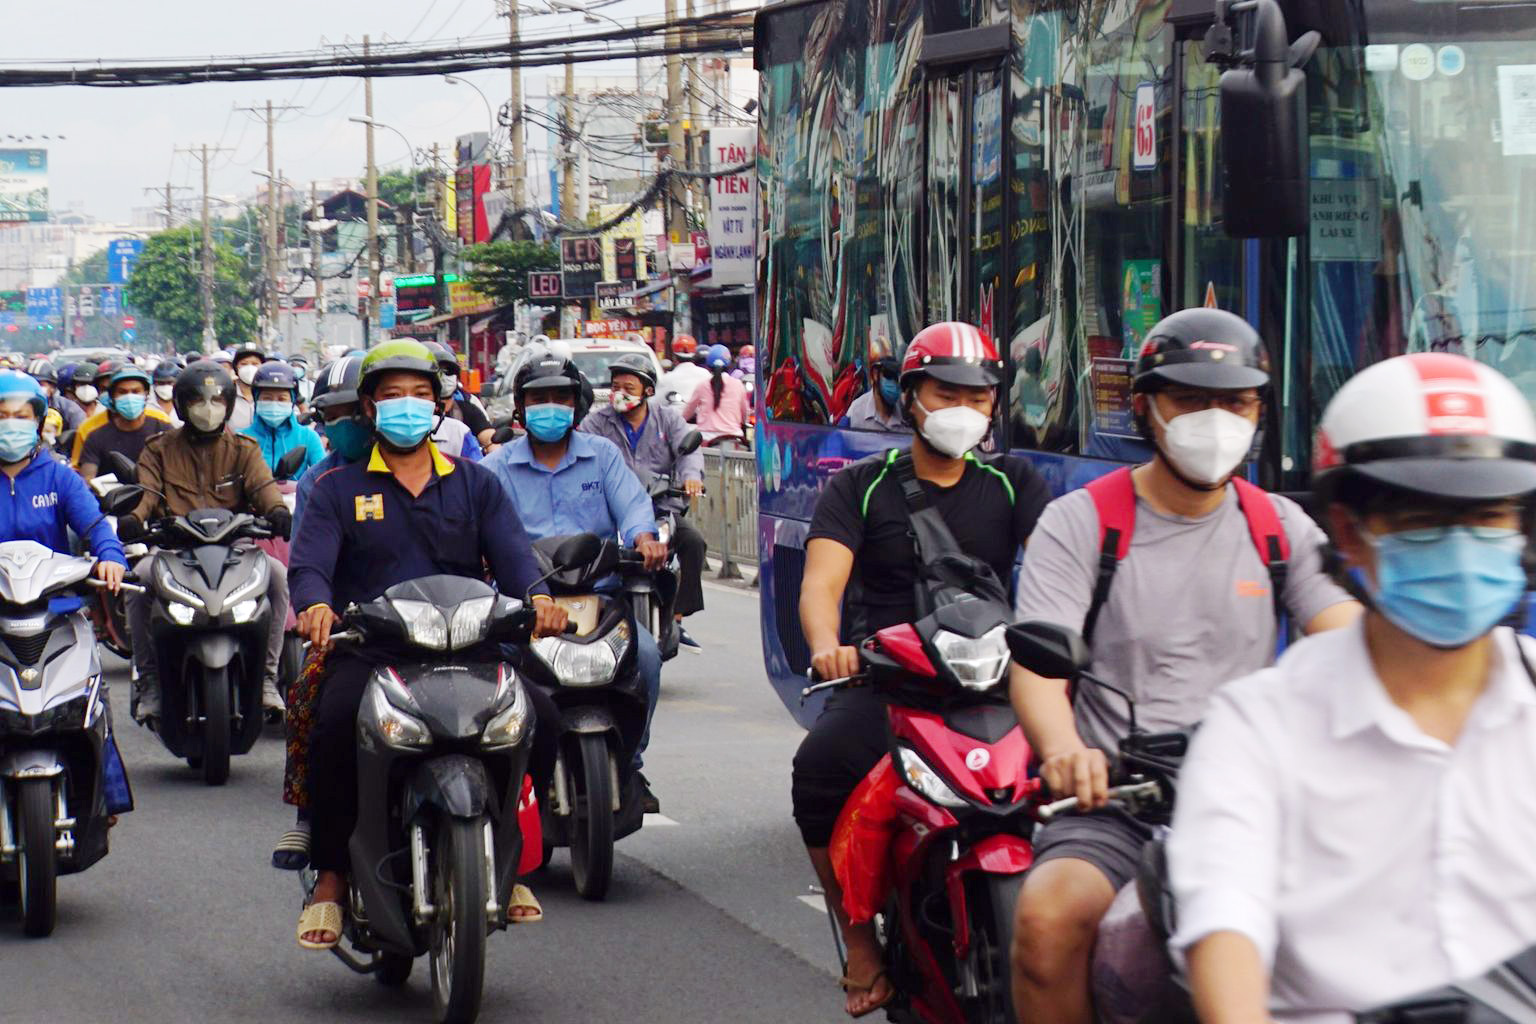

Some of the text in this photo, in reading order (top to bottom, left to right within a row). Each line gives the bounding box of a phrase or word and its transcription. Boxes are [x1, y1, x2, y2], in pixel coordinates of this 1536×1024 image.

[1136, 104, 1153, 157] 65
[717, 142, 747, 164] TÂN
[563, 239, 601, 262] LED
[531, 275, 560, 296] LED
